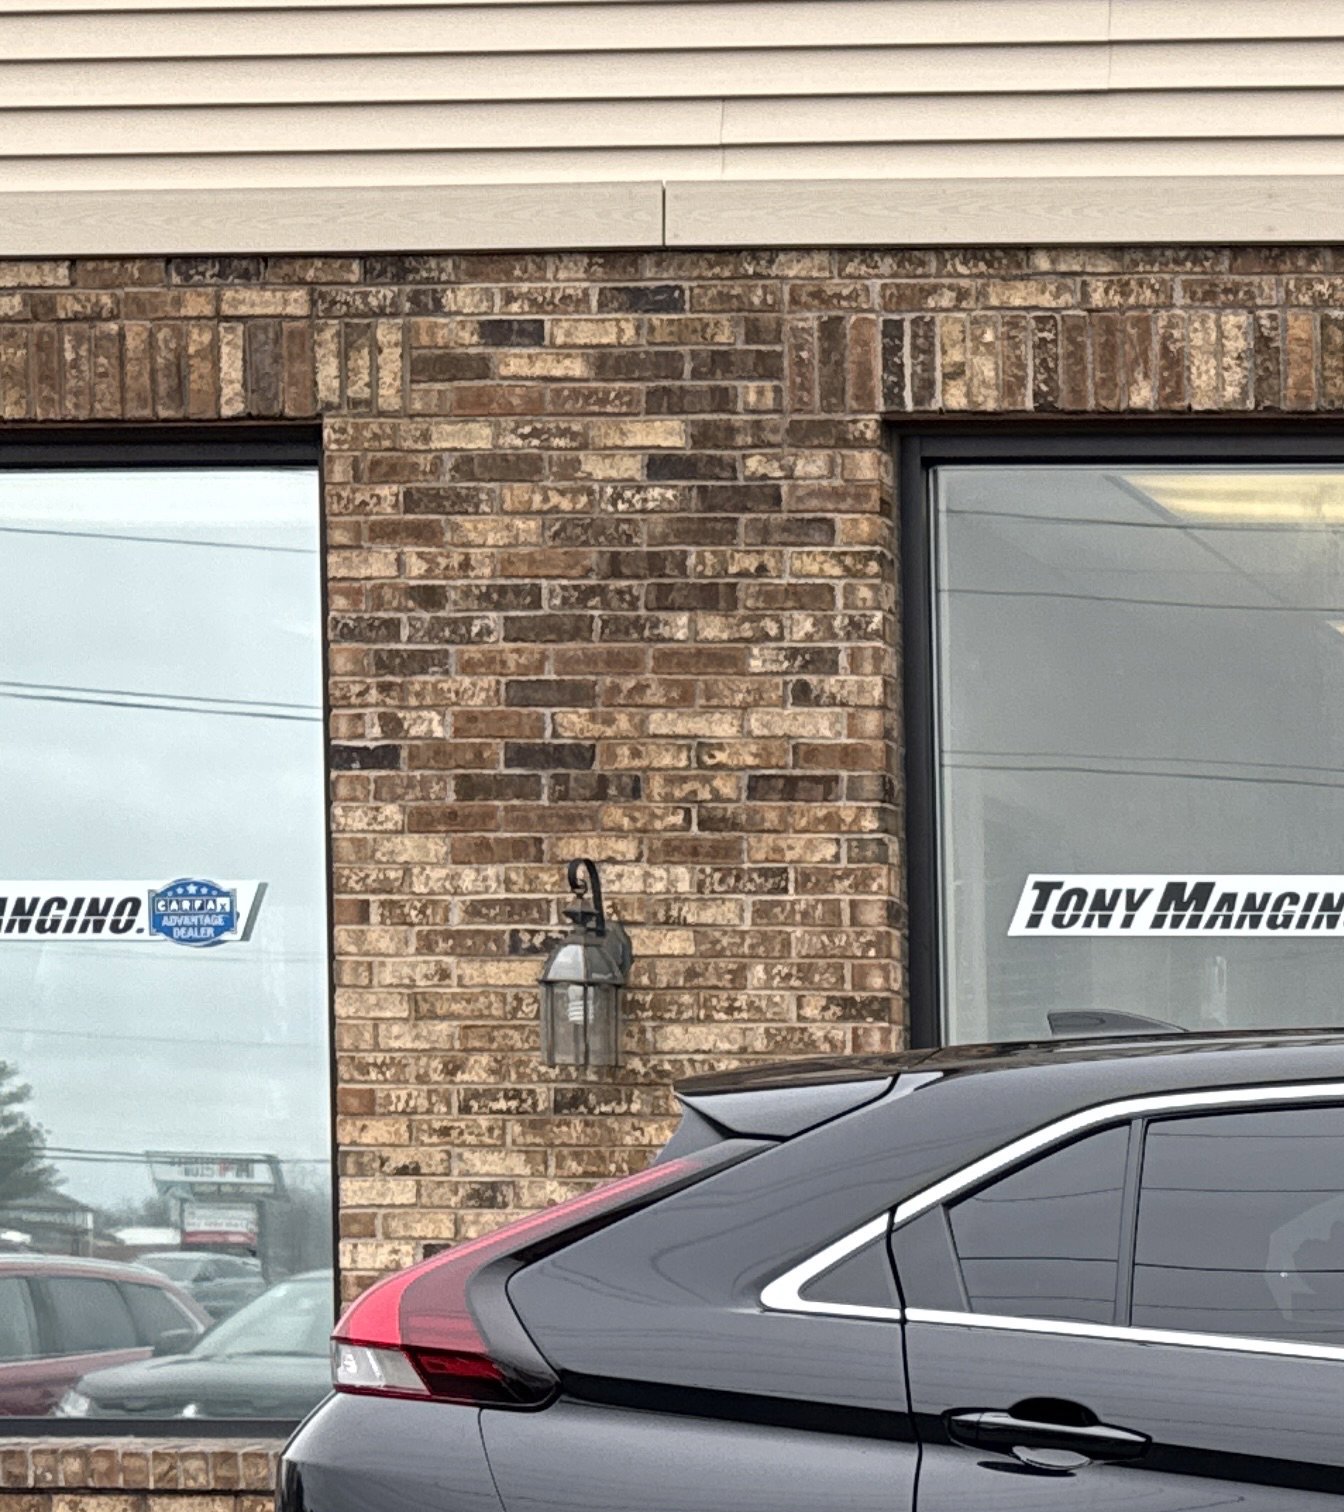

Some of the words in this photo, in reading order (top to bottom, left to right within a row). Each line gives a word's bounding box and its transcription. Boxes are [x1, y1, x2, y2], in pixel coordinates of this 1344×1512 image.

[156, 897, 230, 912] CARFAX
[1025, 881, 1153, 929] TONY
[162, 915, 225, 927] ADVANTAGE
[173, 927, 215, 939] DEALER
